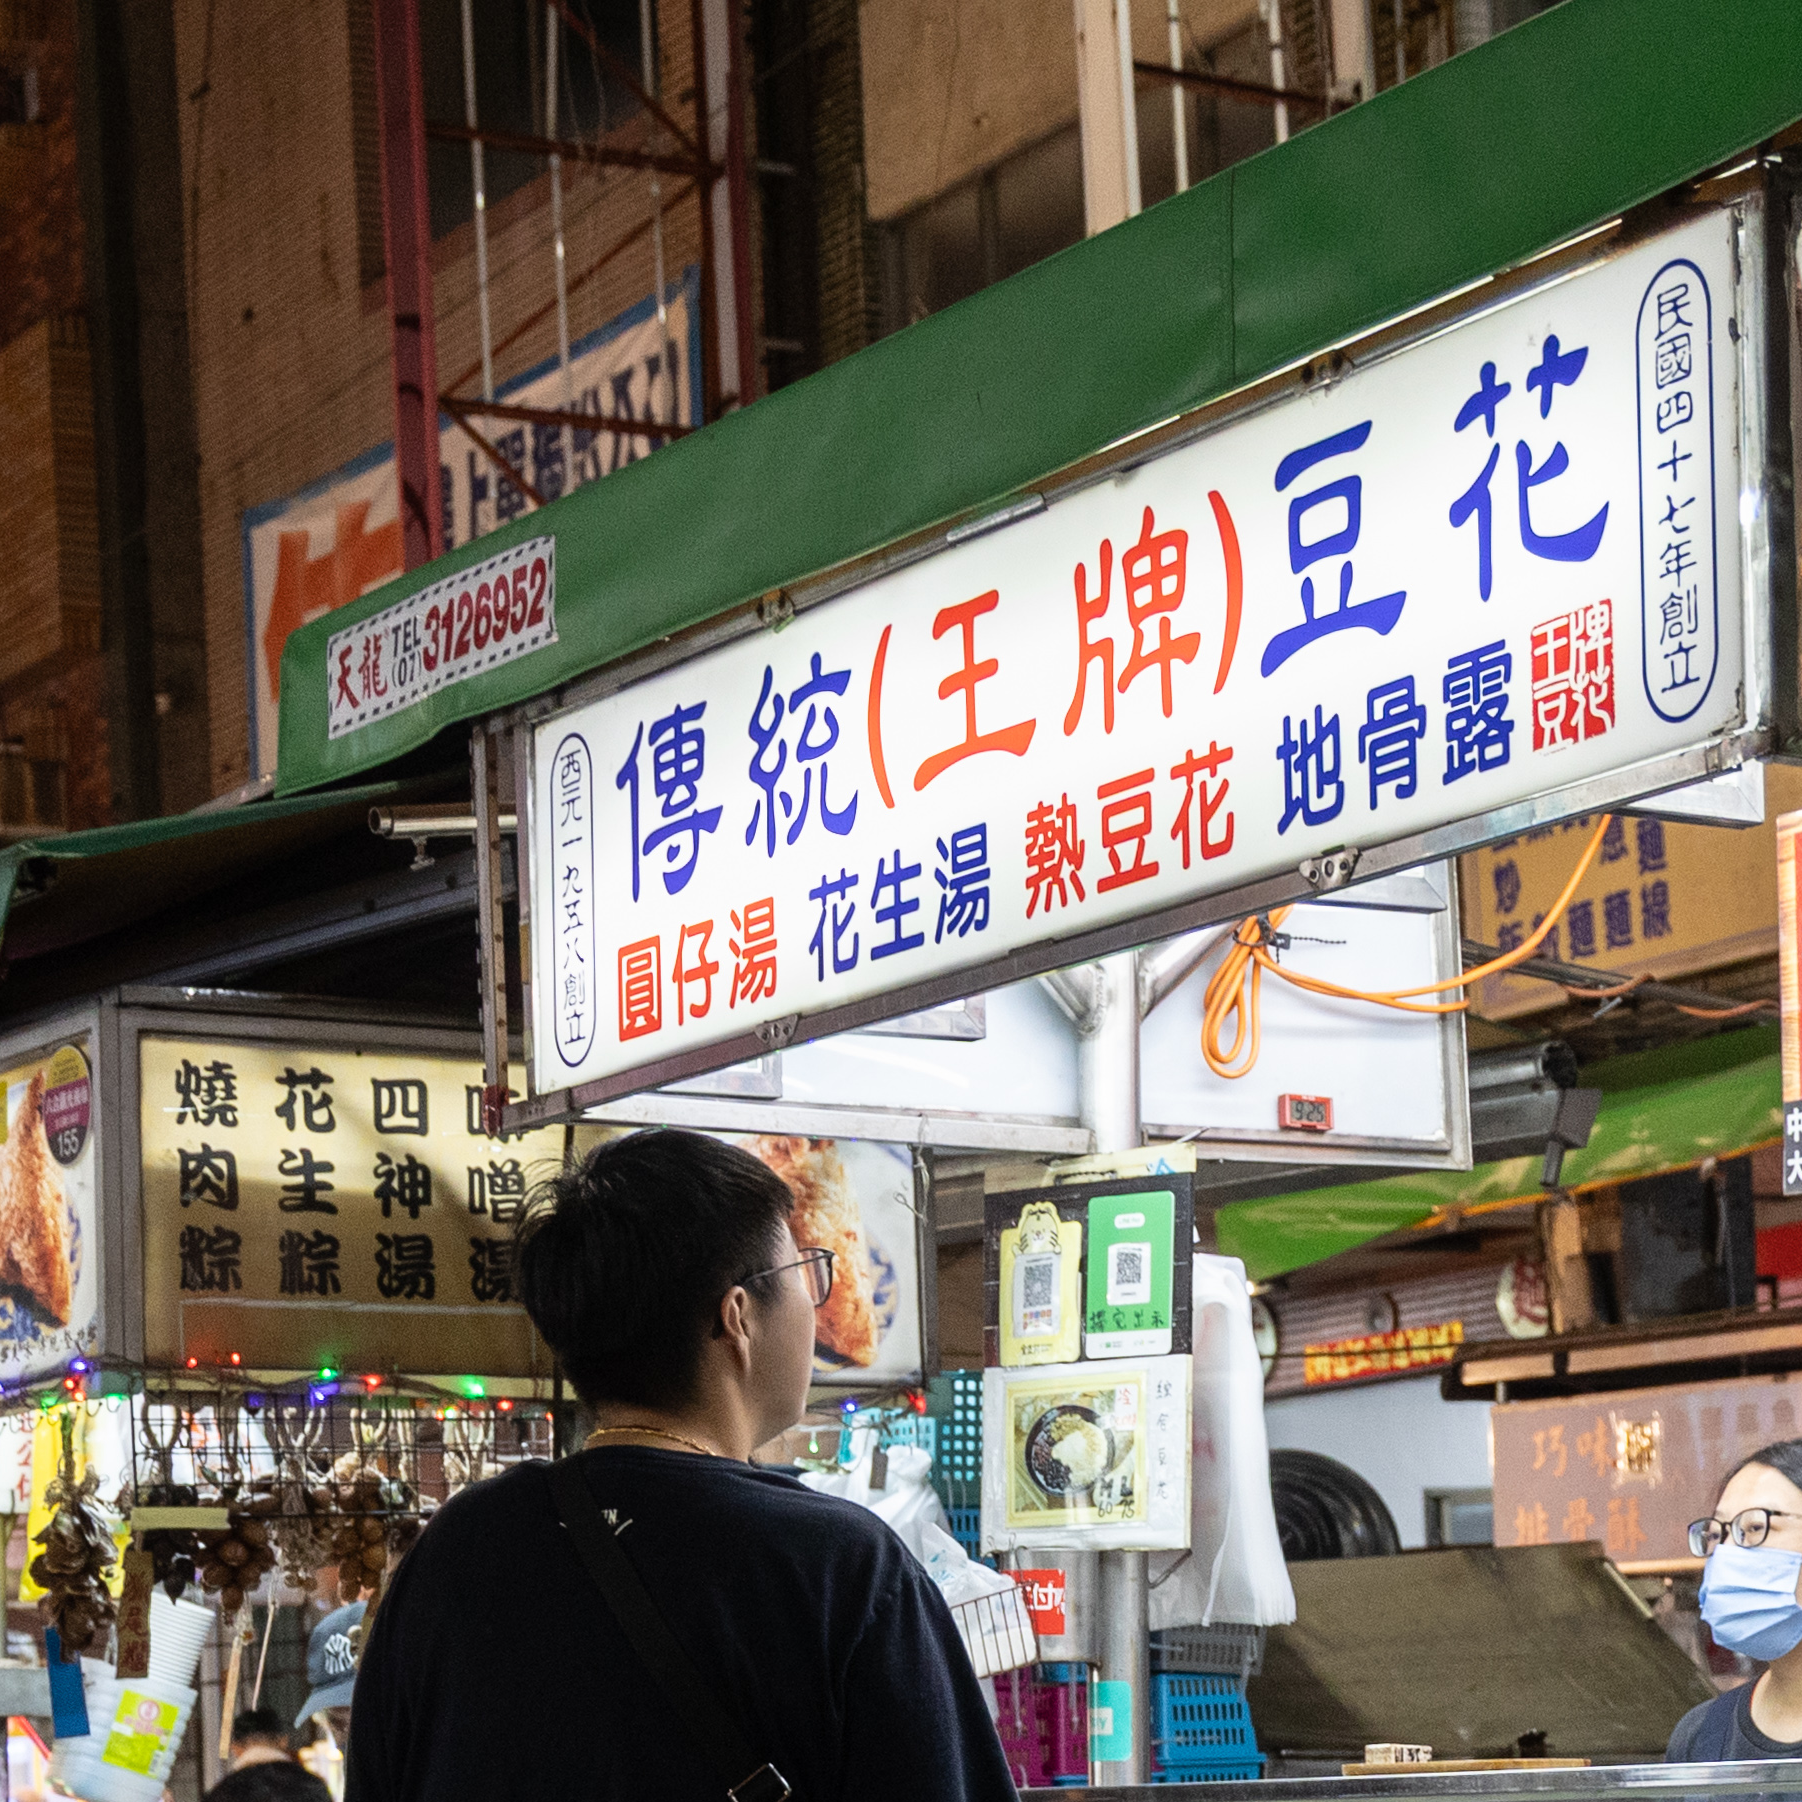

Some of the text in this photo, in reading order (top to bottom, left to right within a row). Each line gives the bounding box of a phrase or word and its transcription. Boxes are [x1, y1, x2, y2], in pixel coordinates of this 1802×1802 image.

[1655, 283, 1701, 694] 民國四十七年創立
[391, 615, 422, 659] TEL
[392, 556, 547, 691] (07) 3126952
[1024, 739, 1235, 920] 熱豆花
[1277, 639, 1515, 836] 地骨露
[557, 750, 588, 1046] 西元一九五八創立
[616, 894, 780, 1044] 圓仔湯
[807, 822, 991, 983] 花生湯
[58, 1126, 79, 1158] 155
[174, 1058, 243, 1292] 燒肉粽
[275, 1067, 342, 1296] 花生粽
[372, 1077, 436, 1301] 四神湯
